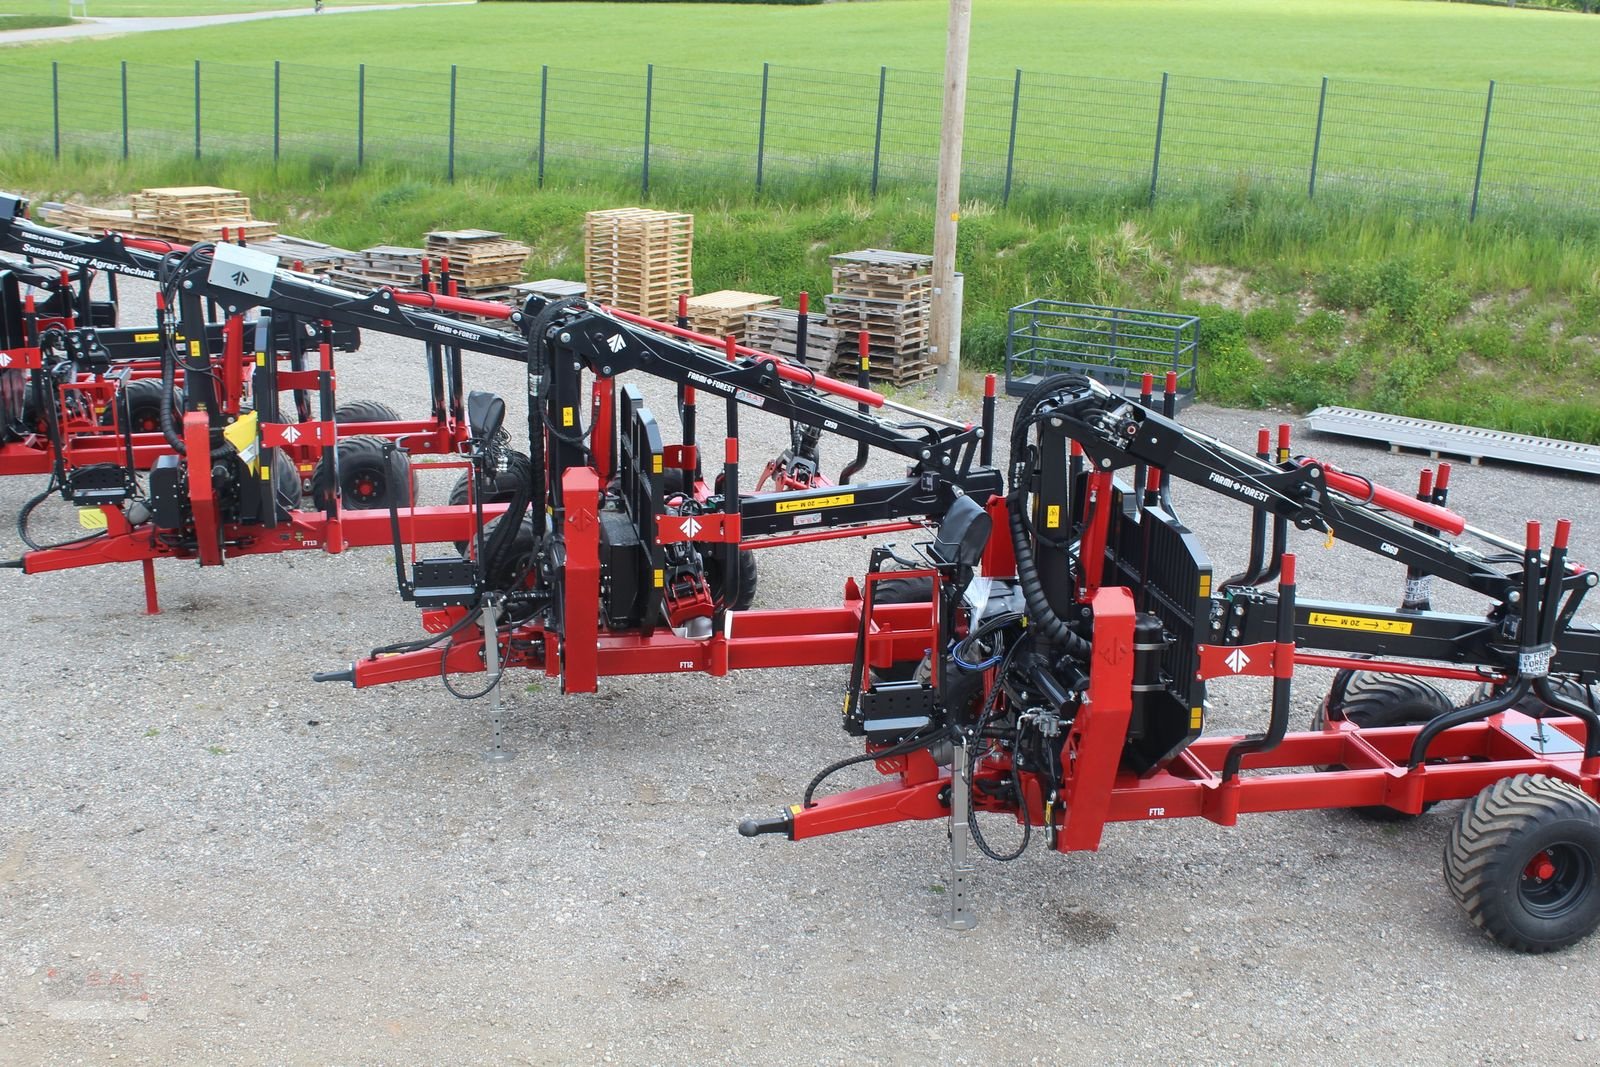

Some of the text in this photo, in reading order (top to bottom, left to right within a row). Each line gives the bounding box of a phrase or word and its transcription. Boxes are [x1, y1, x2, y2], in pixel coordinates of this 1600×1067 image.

[22, 244, 156, 279] Sensenberger Agrar-Technik
[458, 330, 480, 341] FOREST
[688, 372, 736, 393] FARMI FOREST
[1209, 472, 1269, 502] FARMI FOREST
[1350, 619, 1360, 627] 20
[680, 661, 693, 669] FT12
[1149, 807, 1165, 816] FT12
